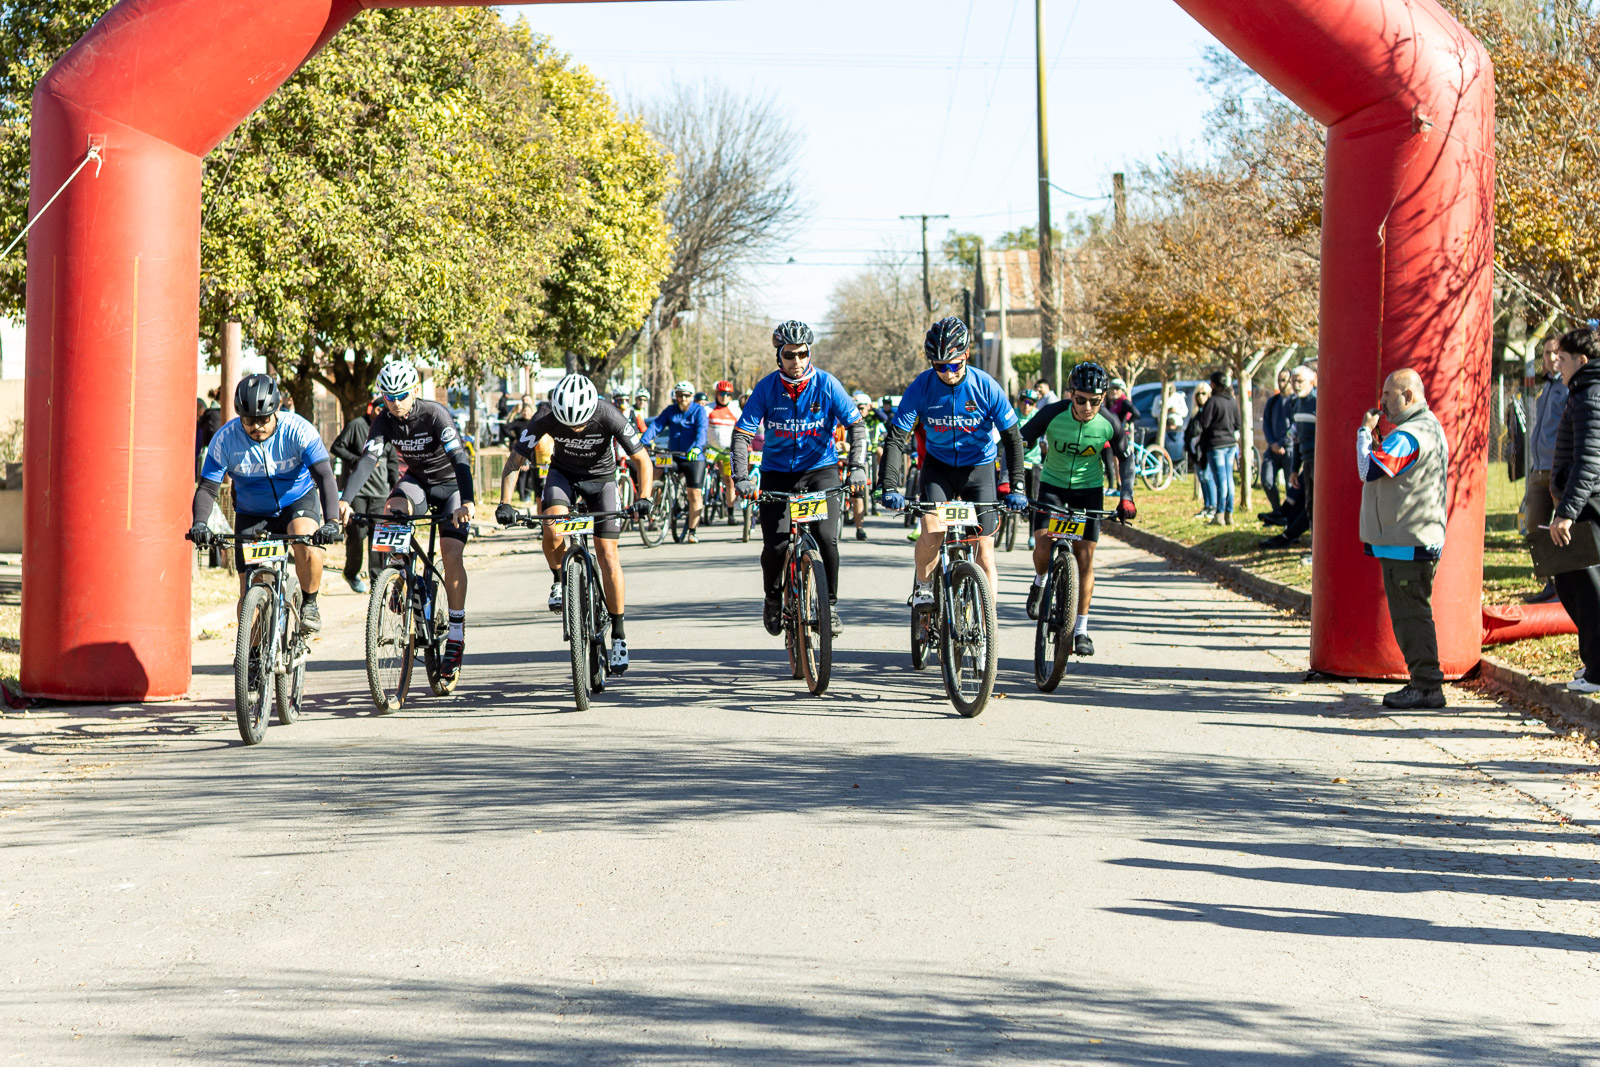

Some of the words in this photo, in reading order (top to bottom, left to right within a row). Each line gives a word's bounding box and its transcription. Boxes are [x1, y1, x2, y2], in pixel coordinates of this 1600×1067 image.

[768, 418, 824, 431] PELOTON
[775, 428, 821, 439] BRUTAL
[391, 436, 433, 447] NACHOS
[554, 437, 605, 445] NACHOS
[564, 442, 593, 450] BIKE
[234, 457, 297, 475] GIANT
[798, 502, 821, 516] 97
[945, 508, 969, 519] 98
[563, 522, 589, 532] 113
[1053, 520, 1080, 534] 119
[375, 531, 407, 546] 215
[251, 546, 278, 558] 101
